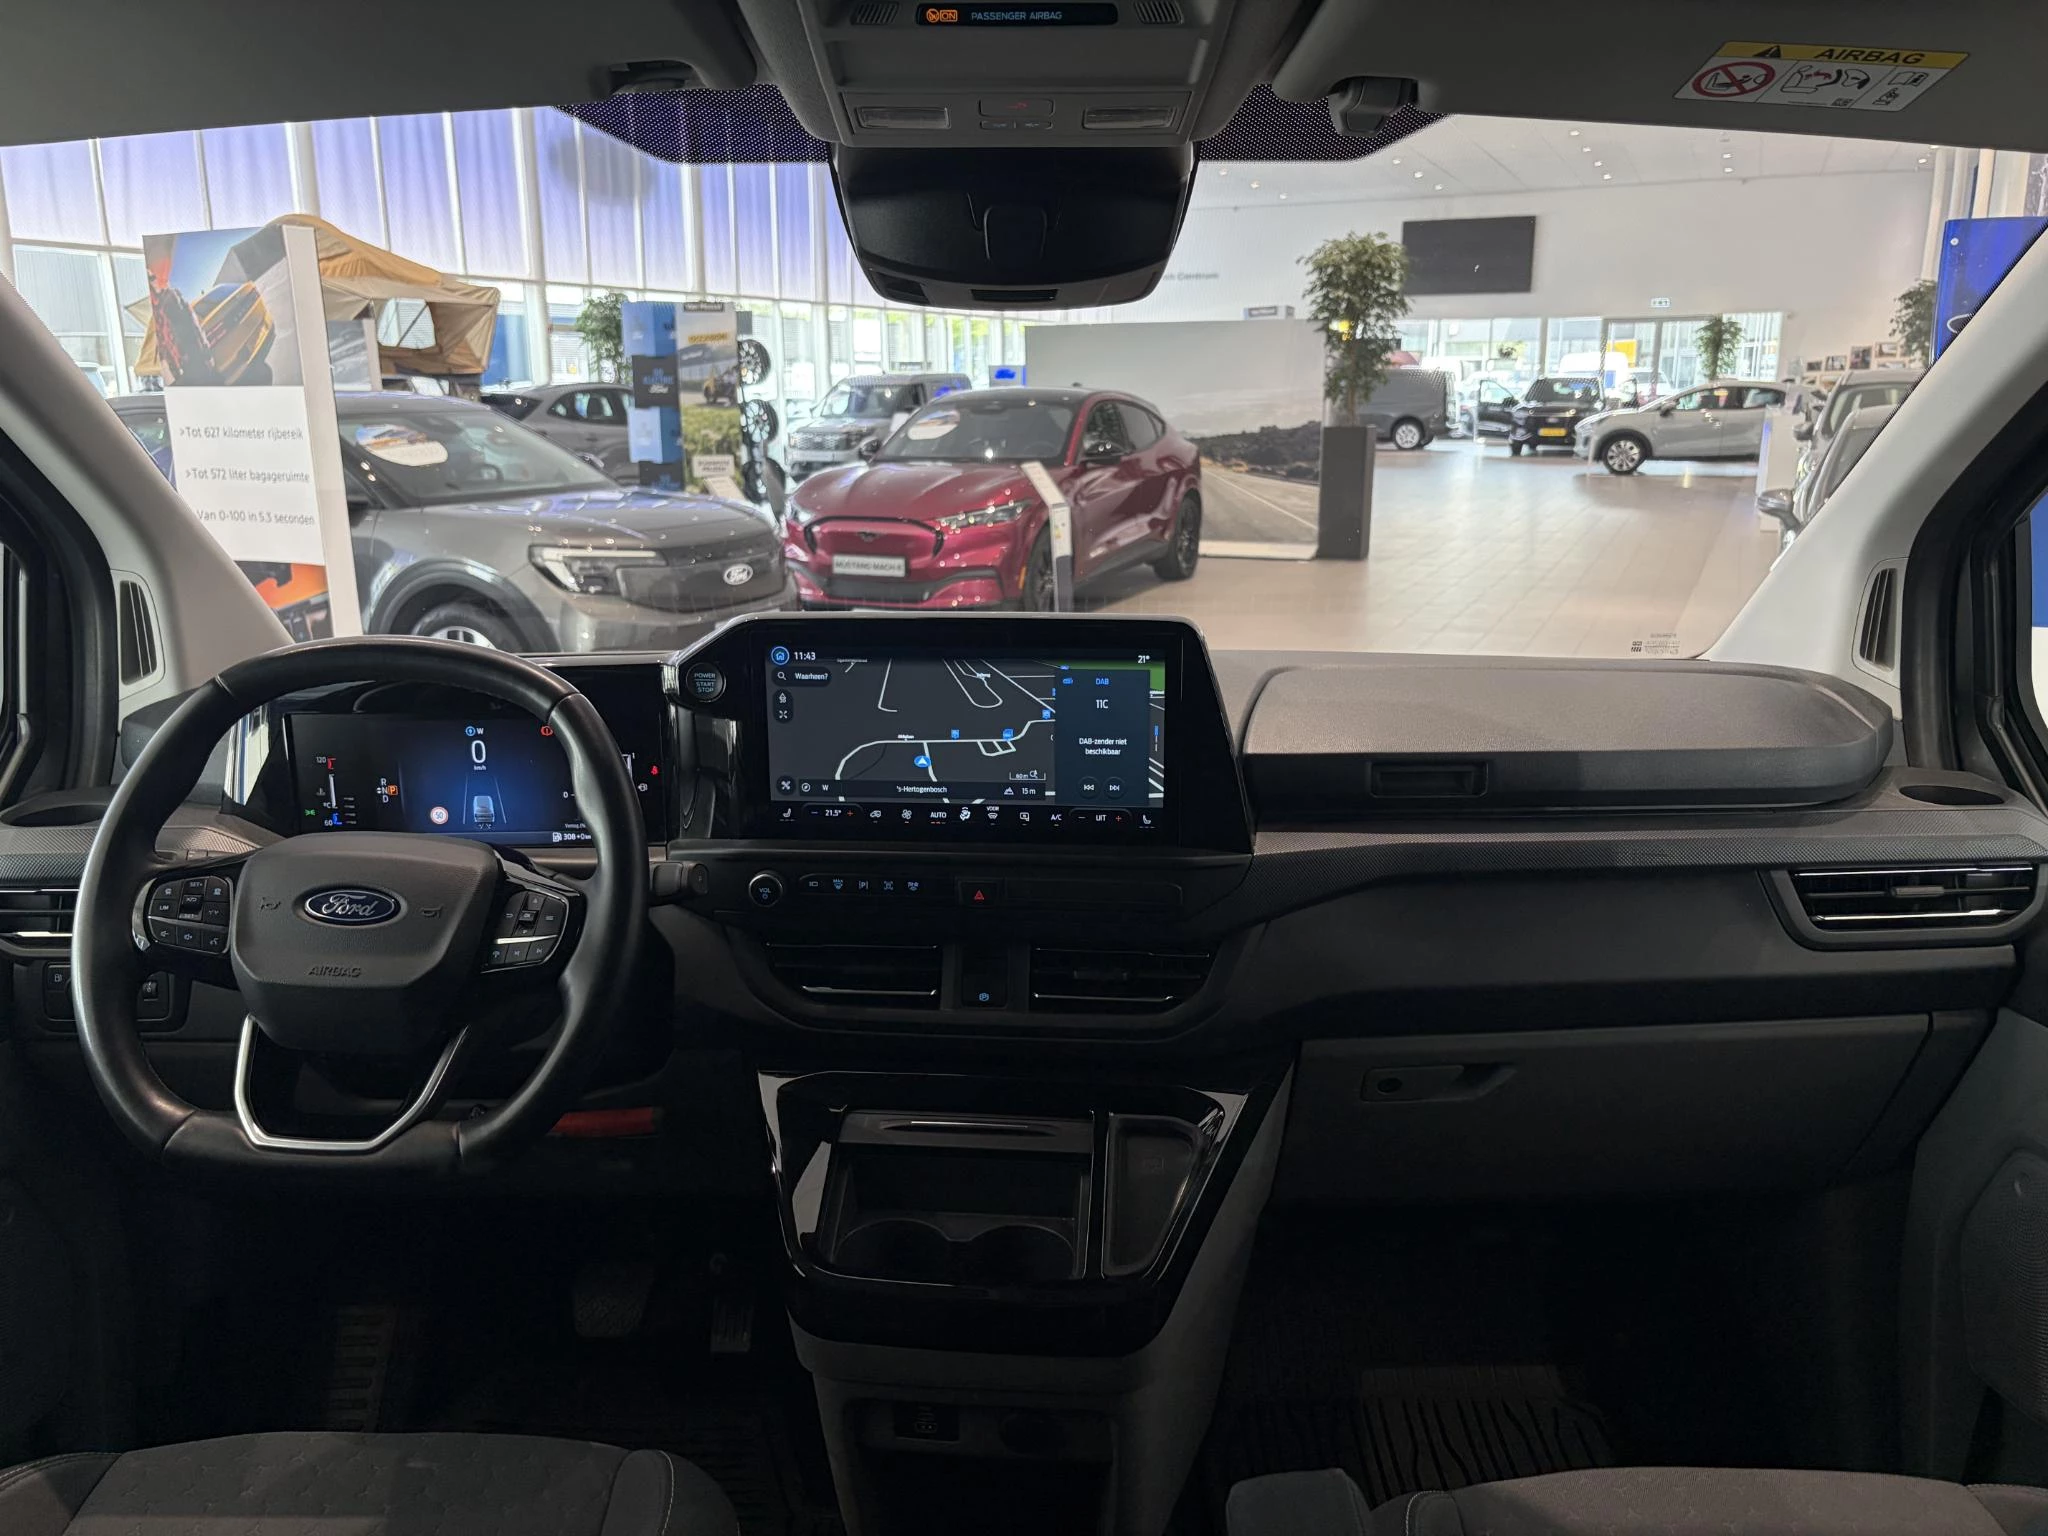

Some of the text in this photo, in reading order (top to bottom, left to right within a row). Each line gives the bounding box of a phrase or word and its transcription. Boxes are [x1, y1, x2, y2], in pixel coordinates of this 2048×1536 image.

[971, 12, 1027, 20] PASSENGER
[1029, 12, 1062, 20] AIRBAG
[1814, 48, 1926, 65] AIRBAG
[229, 469, 247, 481] liter
[250, 471, 310, 483] bagageruimte
[250, 511, 257, 521] in
[274, 513, 315, 525] seconden
[794, 652, 816, 661] 11:43
[1137, 655, 1150, 664] 21°
[794, 672, 828, 681] Waarheen?
[1095, 699, 1109, 709] 11C
[471, 740, 486, 764] 0
[381, 778, 387, 786] R
[382, 795, 389, 803] D
[825, 809, 842, 817] 21.5°
[1095, 814, 1107, 822] UIT
[324, 819, 333, 827] 60
[322, 895, 377, 917] Ford
[308, 966, 362, 978] AIRBAG
